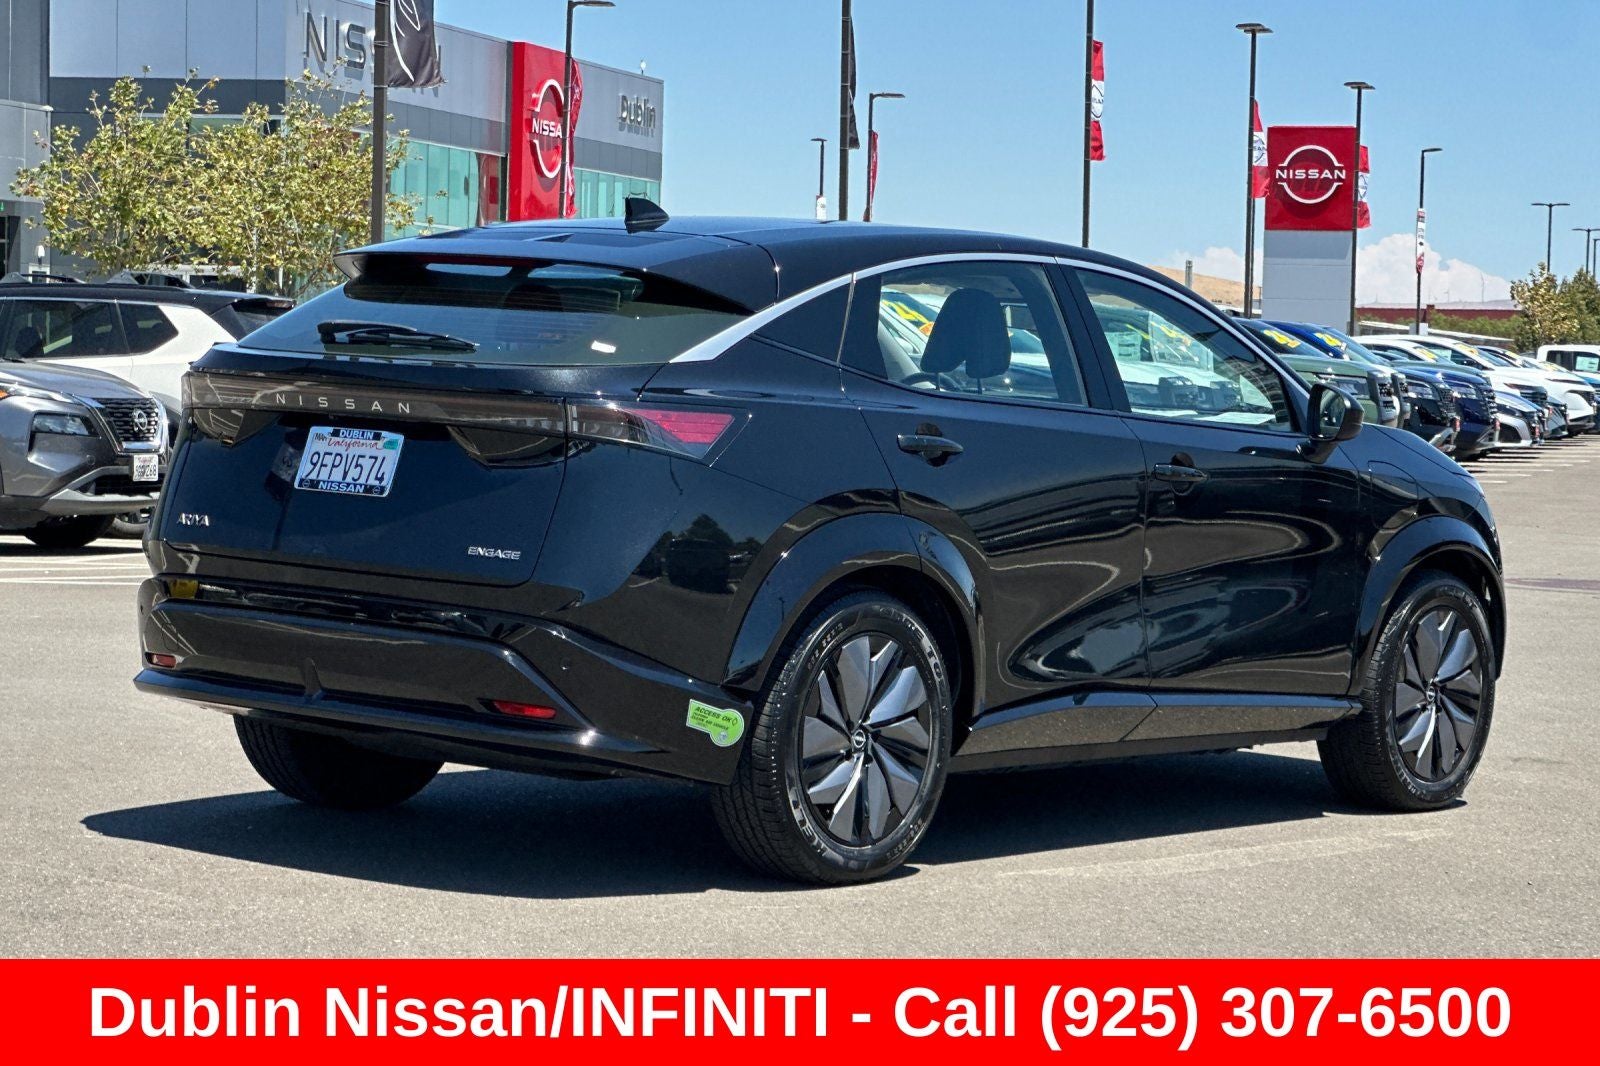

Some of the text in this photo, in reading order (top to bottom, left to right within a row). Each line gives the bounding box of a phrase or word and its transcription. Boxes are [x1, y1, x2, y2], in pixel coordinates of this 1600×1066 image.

[618, 94, 656, 129] Dublin
[532, 117, 563, 139] NISSA
[1275, 169, 1346, 180] NISSAN
[276, 393, 410, 414] NISSAN
[339, 429, 375, 440] DUBLIN
[304, 451, 387, 485] 9FPV574
[318, 481, 365, 493] NISSAN
[467, 546, 521, 560] ENGAGE
